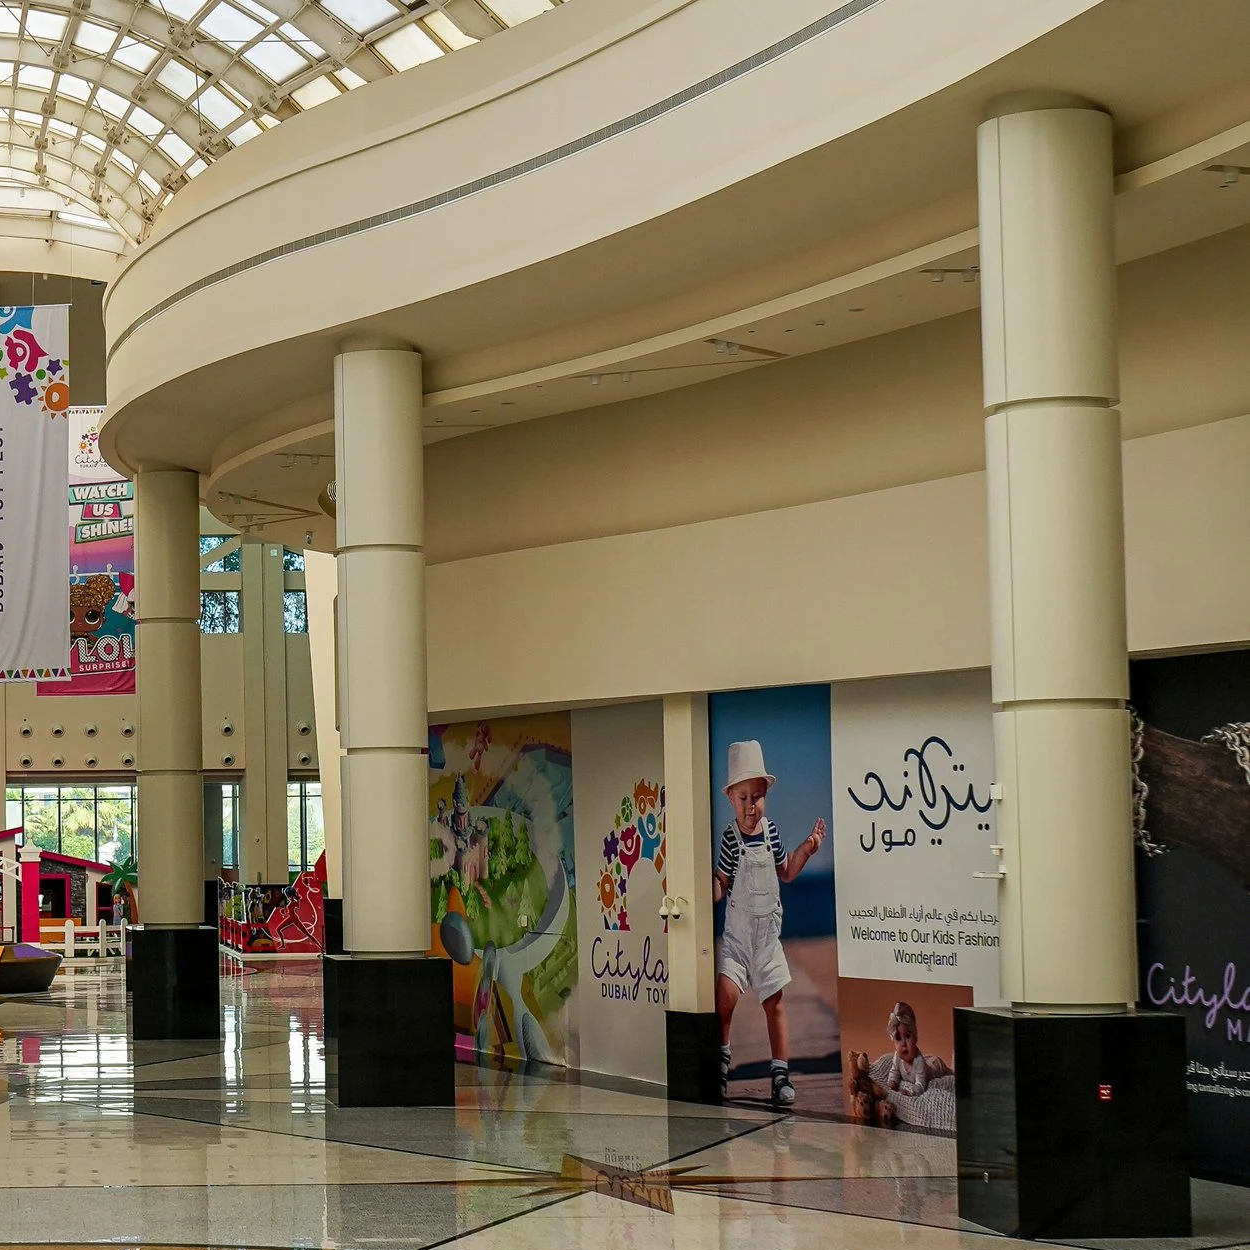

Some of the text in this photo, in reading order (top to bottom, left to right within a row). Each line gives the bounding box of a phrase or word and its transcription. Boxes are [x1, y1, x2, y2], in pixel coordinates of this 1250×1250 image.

[74, 454, 107, 468] Cityl
[73, 483, 128, 501] WATCH
[92, 503, 114, 517] US
[81, 518, 134, 540] SHINE!
[79, 660, 130, 672] SURPRISE!
[859, 822, 916, 852] مول
[850, 926, 1000, 947] Welcome to Our Kids Fashion
[893, 949, 958, 967] Wonderland!
[591, 935, 669, 1001] Cityla
[601, 982, 667, 1004] DUBAI TOY
